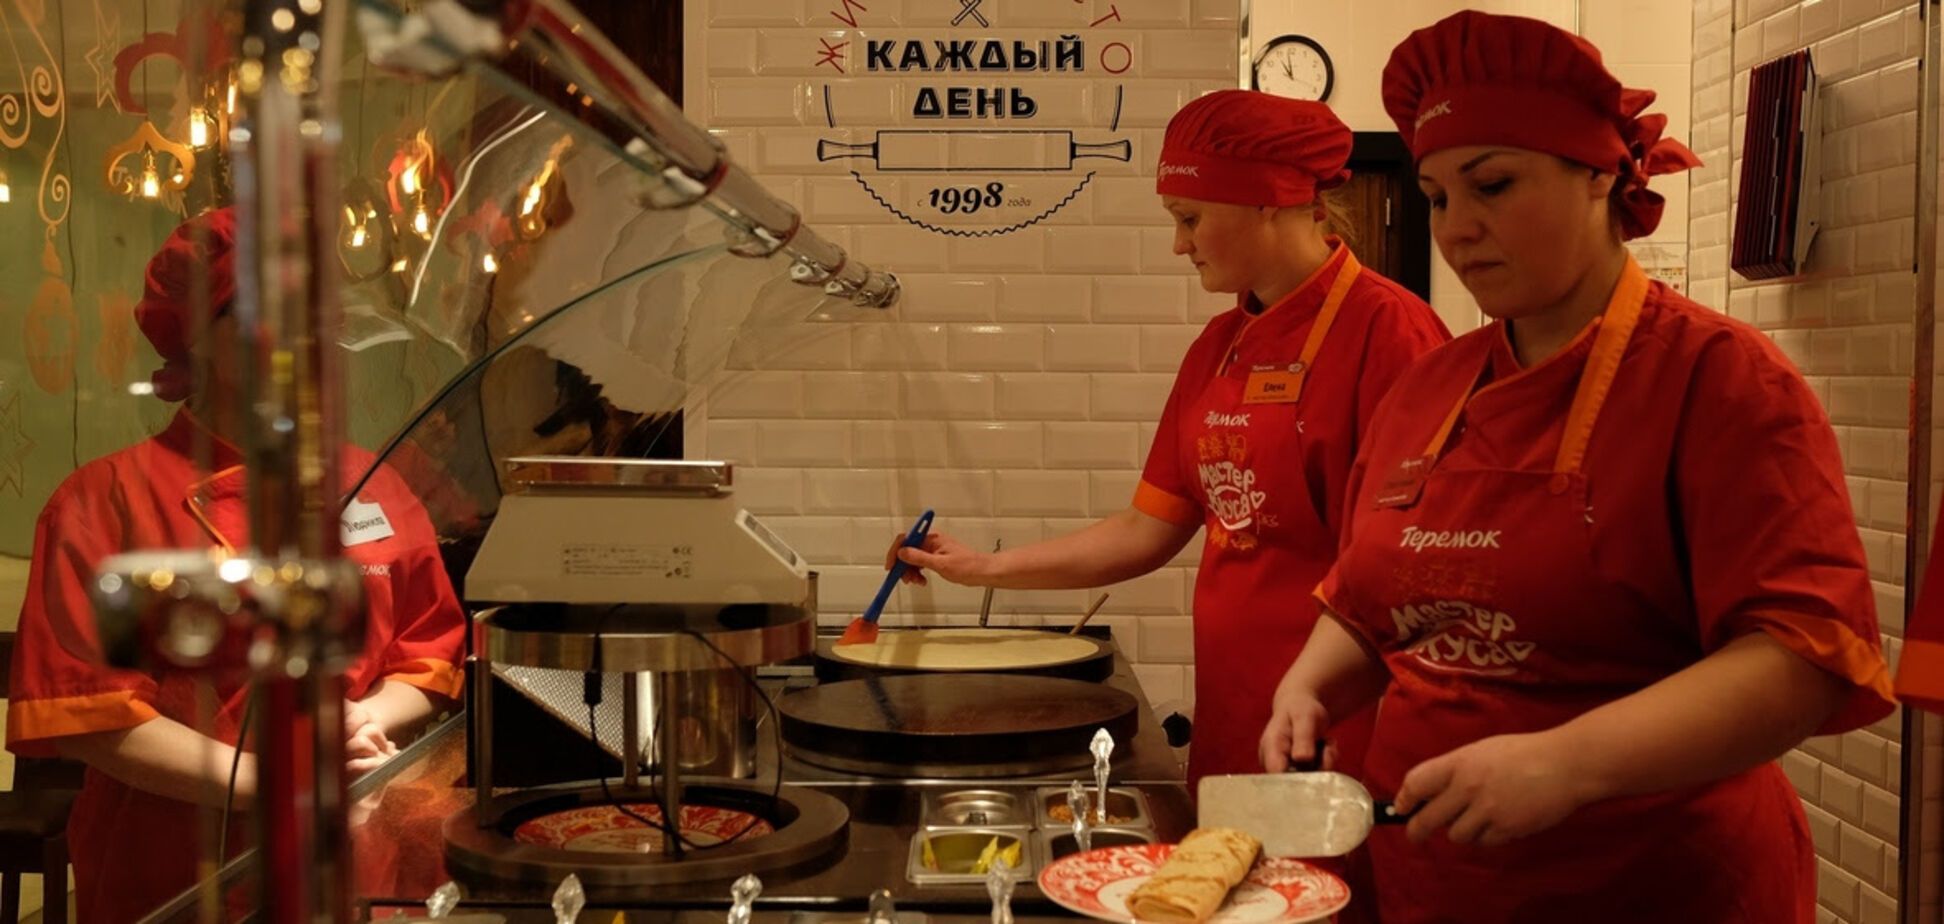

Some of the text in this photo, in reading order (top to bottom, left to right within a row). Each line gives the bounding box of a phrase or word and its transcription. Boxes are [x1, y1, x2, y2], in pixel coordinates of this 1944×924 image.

[867, 35, 1085, 72] КАЖДЫЙ
[913, 87, 1038, 119] ДЕНЬ
[929, 182, 1004, 214] 1998
[1007, 197, 1032, 207] года
[1400, 525, 1502, 553] Теремок
